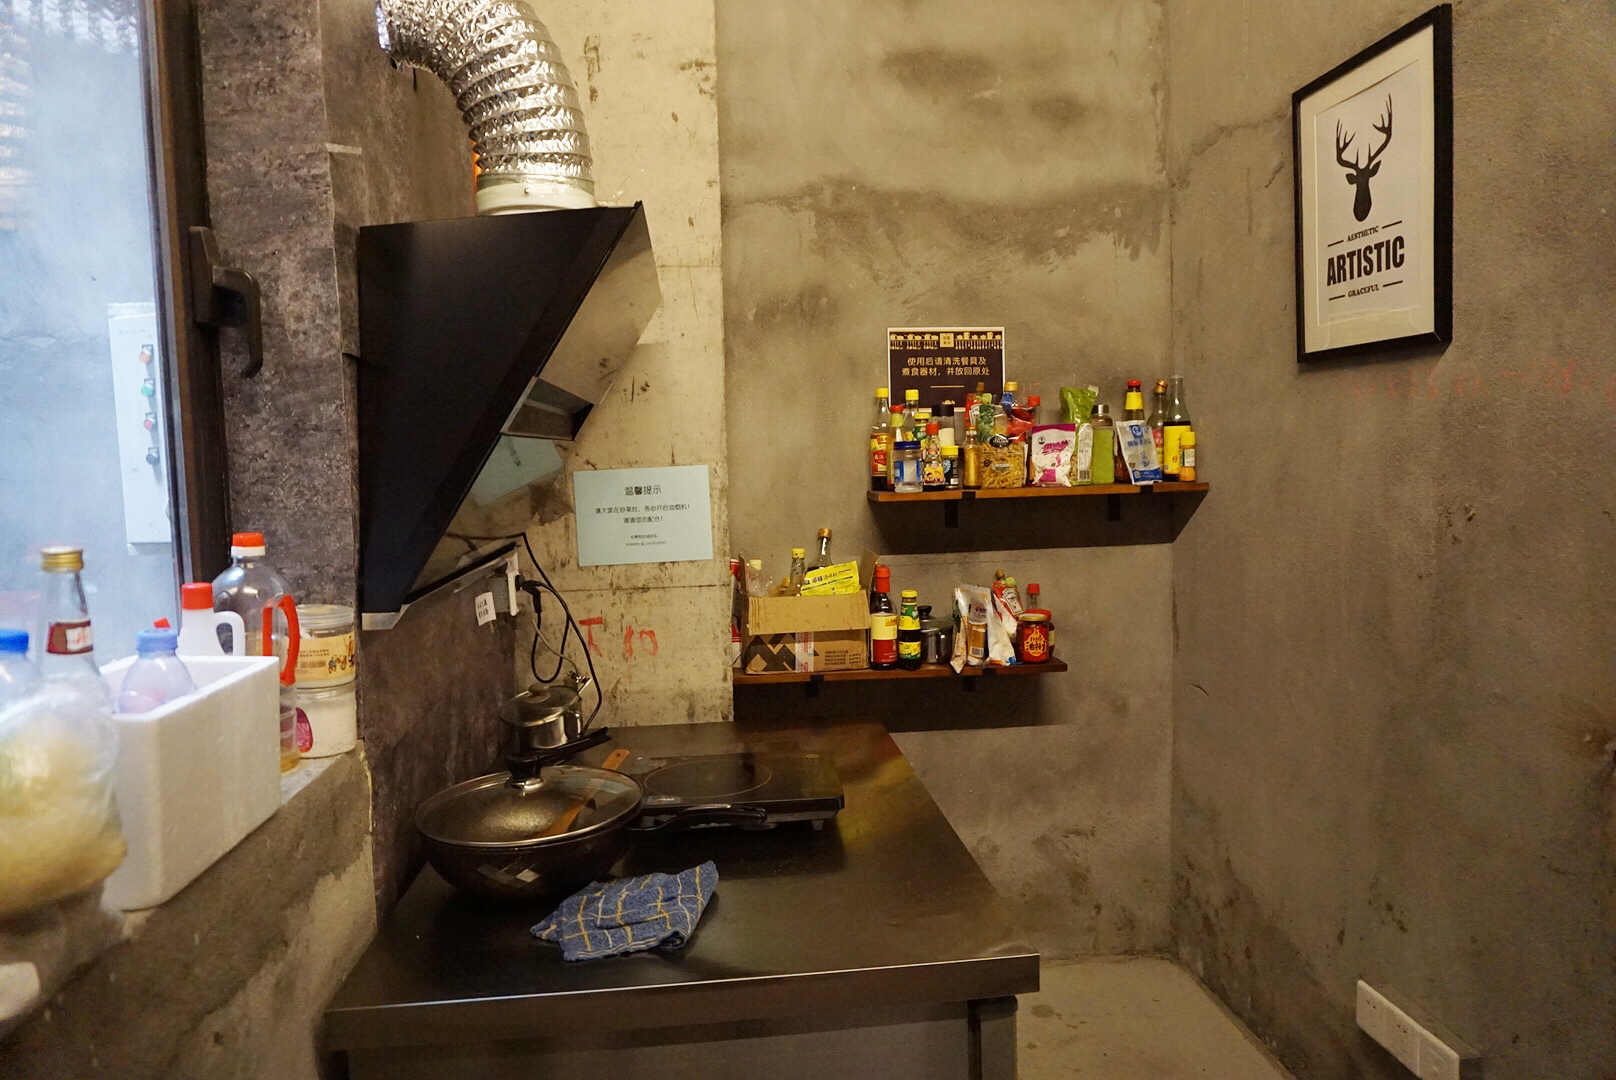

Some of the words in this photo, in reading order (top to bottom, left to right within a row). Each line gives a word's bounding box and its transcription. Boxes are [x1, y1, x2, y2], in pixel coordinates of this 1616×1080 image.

[1346, 226, 1380, 243] AESTHETIC
[1326, 235, 1405, 286] ARTISTIC
[1347, 283, 1380, 298] GRACEFUL
[907, 356, 987, 366] 使用后请清洗餐具及
[624, 485, 662, 496] 温馨提示
